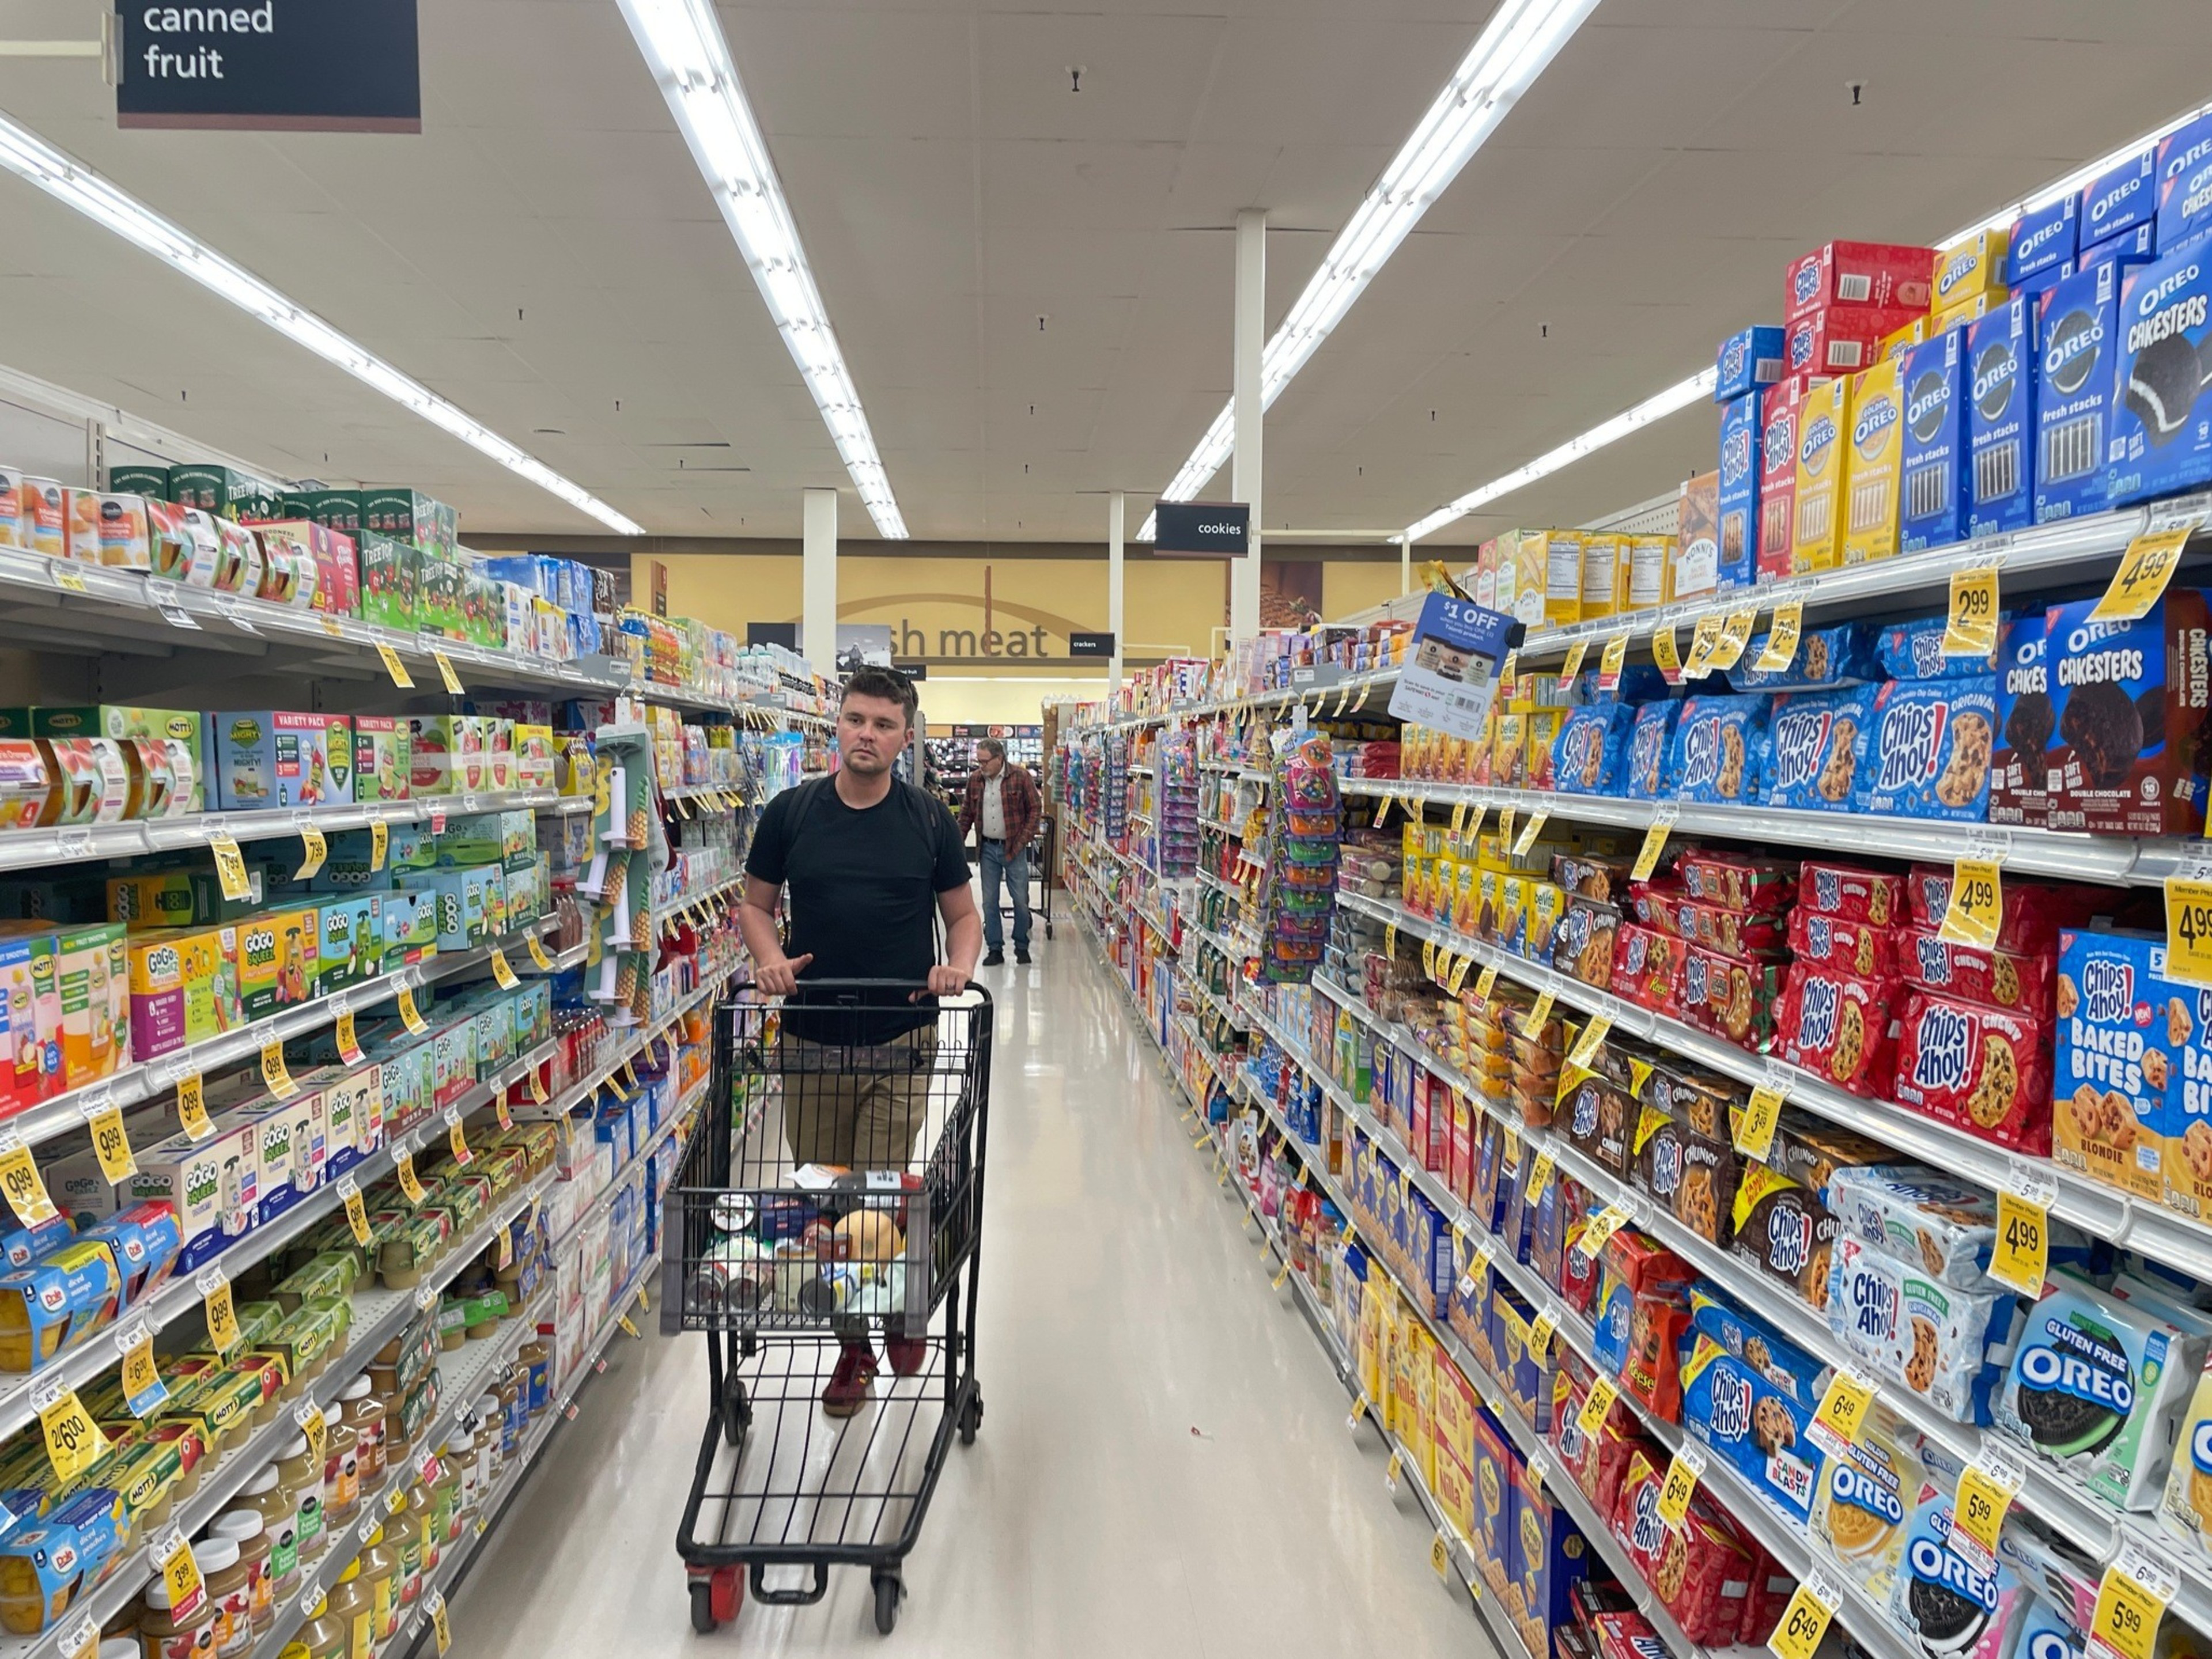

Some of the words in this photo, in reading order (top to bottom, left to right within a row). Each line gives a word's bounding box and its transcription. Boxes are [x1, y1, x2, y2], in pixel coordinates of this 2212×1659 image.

[143, 0, 273, 33] canned
[144, 46, 224, 79] fruit
[2092, 178, 2141, 222] OREO
[2018, 221, 2063, 260] OREO
[1939, 256, 1977, 294] OREO
[2138, 264, 2199, 317] OREO
[2127, 294, 2209, 355] CAKESTERS
[2045, 325, 2104, 374] OREO
[1972, 358, 2017, 403] OREO
[1863, 397, 1889, 419] GOLDEN
[1907, 385, 1951, 425] OREO
[2042, 404, 2068, 424] fresh
[2069, 394, 2103, 414] stacks
[1764, 419, 1789, 452] Chips
[1808, 418, 1829, 436] GOLDEN
[1854, 407, 1897, 443] OREO
[1972, 432, 1992, 448] fresh
[1992, 421, 2020, 440] stacks
[1723, 435, 1744, 464] Chips
[1802, 425, 1836, 460] OREO
[1905, 451, 1924, 468] fresh
[1924, 444, 1950, 461] stacks
[1198, 523, 1241, 535] cookies
[364, 547, 381, 567] TREE
[380, 542, 394, 559] TOP
[1443, 601, 1459, 619] $1
[1464, 609, 1499, 630] OFF
[940, 625, 1048, 657] meat
[1912, 636, 1939, 664] Chips
[2068, 620, 2131, 653] OREO
[2058, 649, 2143, 687] CAKESTERS
[2190, 628, 2209, 709] CAKESTERS
[279, 715, 308, 726] VARIETY
[308, 717, 326, 727] PACK
[358, 719, 378, 729] VARIETY
[378, 721, 393, 730] PACK
[1834, 703, 1865, 719] ORIGINAL
[168, 724, 193, 734] MOTT'S
[230, 730, 262, 741] MIGHTY
[277, 737, 282, 747] 6
[1685, 720, 1714, 758] Chips
[1778, 713, 1822, 762] Chips
[1881, 704, 1934, 760] Chips
[233, 757, 262, 768] MIGHTY!
[278, 750, 283, 762] 3
[1780, 732, 1825, 785] Ahoy!
[1880, 726, 1940, 789] Ahoy!
[2010, 789, 2033, 797] DOUBLE
[2070, 790, 2094, 798] DOUBLE
[2094, 790, 2131, 798] CHOCOLATE
[309, 842, 323, 861] 799
[375, 833, 384, 853] 799
[466, 882, 481, 897] GOGO
[1815, 870, 1837, 894] Chips
[1843, 884, 1867, 898] CHEWY
[2174, 886, 2199, 895] Member
[417, 902, 434, 918] GOGO
[1534, 890, 1555, 908] belVita
[1959, 879, 1993, 916] 499
[326, 913, 348, 931] GOGO
[444, 893, 459, 934] GOGO
[245, 930, 275, 953] GOGO
[328, 929, 349, 944] SQUEEZ
[1808, 917, 1830, 940] Chips
[1834, 933, 1855, 948] CHEWY
[247, 951, 275, 966] SQUEEZ
[1918, 937, 1945, 965] Chips
[1954, 955, 1987, 972] CHEWY
[2154, 953, 2162, 967] 5
[33, 960, 55, 973] MOTT'S
[2084, 963, 2124, 996] Chips
[1803, 979, 1835, 1018] Chips
[1844, 983, 1870, 1006] CHEWY
[2088, 980, 2130, 1023] Ahoy!
[1798, 1001, 1838, 1051] Ahoy!
[1919, 1006, 1967, 1048] Chips
[1982, 1014, 2022, 1041] CHEWY
[2071, 1017, 2144, 1062] BAKED
[265, 1055, 281, 1081] 999
[1916, 1034, 1974, 1093] Ahoy!
[2071, 1048, 2142, 1096] BITES
[182, 1090, 198, 1121] 999
[330, 1094, 351, 1115] GOGO
[1672, 1086, 1698, 1103] CHUNKY
[262, 1122, 290, 1149] GOGO
[1750, 1113, 1767, 1134] 349
[99, 1126, 120, 1162] 999
[264, 1143, 290, 1165] SQUEEZ
[1684, 1144, 1718, 1166] CHUNKY
[1787, 1145, 1818, 1167] CHUNKY
[2081, 1139, 2124, 1165] BLONDIE
[6, 1166, 32, 1199] 999
[130, 1173, 172, 1188] GOGO
[185, 1162, 218, 1191] GOGO
[400, 1172, 413, 1189] 999
[131, 1185, 173, 1198] SQUEEZ
[187, 1182, 218, 1207] SQUEEZ
[350, 1204, 362, 1222] 999
[1769, 1206, 1803, 1240] Chips
[145, 1229, 158, 1241] diced
[2005, 1215, 2039, 1256] 499
[127, 1243, 142, 1258] Dole
[1770, 1230, 1809, 1276] Ahoy!
[67, 1272, 85, 1288] diced
[1853, 1272, 1893, 1313] Chips
[44, 1288, 63, 1305] Dole
[1905, 1278, 1927, 1301] GLUTEN
[1927, 1290, 1946, 1310] FREE!
[211, 1302, 229, 1332] 999
[1858, 1297, 1897, 1342] Ahoy!
[299, 1332, 319, 1355] MOTT'S
[2047, 1320, 2094, 1354] GLUTEN
[2094, 1344, 2127, 1372] FREE
[1395, 1373, 1417, 1410] Nilla
[1712, 1369, 1744, 1407] Chips
[2022, 1347, 2132, 1409] OREO
[215, 1397, 240, 1420] MOTT'S
[1588, 1390, 1607, 1415] 649
[1833, 1394, 1855, 1416] 649
[1711, 1396, 1749, 1440] Ahoy!
[51, 1414, 86, 1452] 2/600
[1865, 1438, 1890, 1463] GOLDEN
[1775, 1456, 1809, 1483] CANDY
[1848, 1443, 1878, 1475] GLUTEN
[1876, 1464, 1900, 1489] FREE
[131, 1476, 156, 1503] MOTT'S
[1439, 1467, 1462, 1512] Nilla
[1666, 1474, 1688, 1502] 649
[1772, 1468, 1808, 1497] BLASTS
[1832, 1463, 1903, 1524] OREO
[1967, 1493, 1991, 1521] 599
[79, 1529, 96, 1546] diced
[82, 1532, 107, 1557] peaches
[55, 1548, 75, 1568] Dole
[175, 1563, 190, 1589] 399
[1911, 1539, 1999, 1611] OREO
[2135, 1566, 2157, 1584] 699
[1787, 1607, 1818, 1641] 649
[2112, 1600, 2142, 1633] 599
